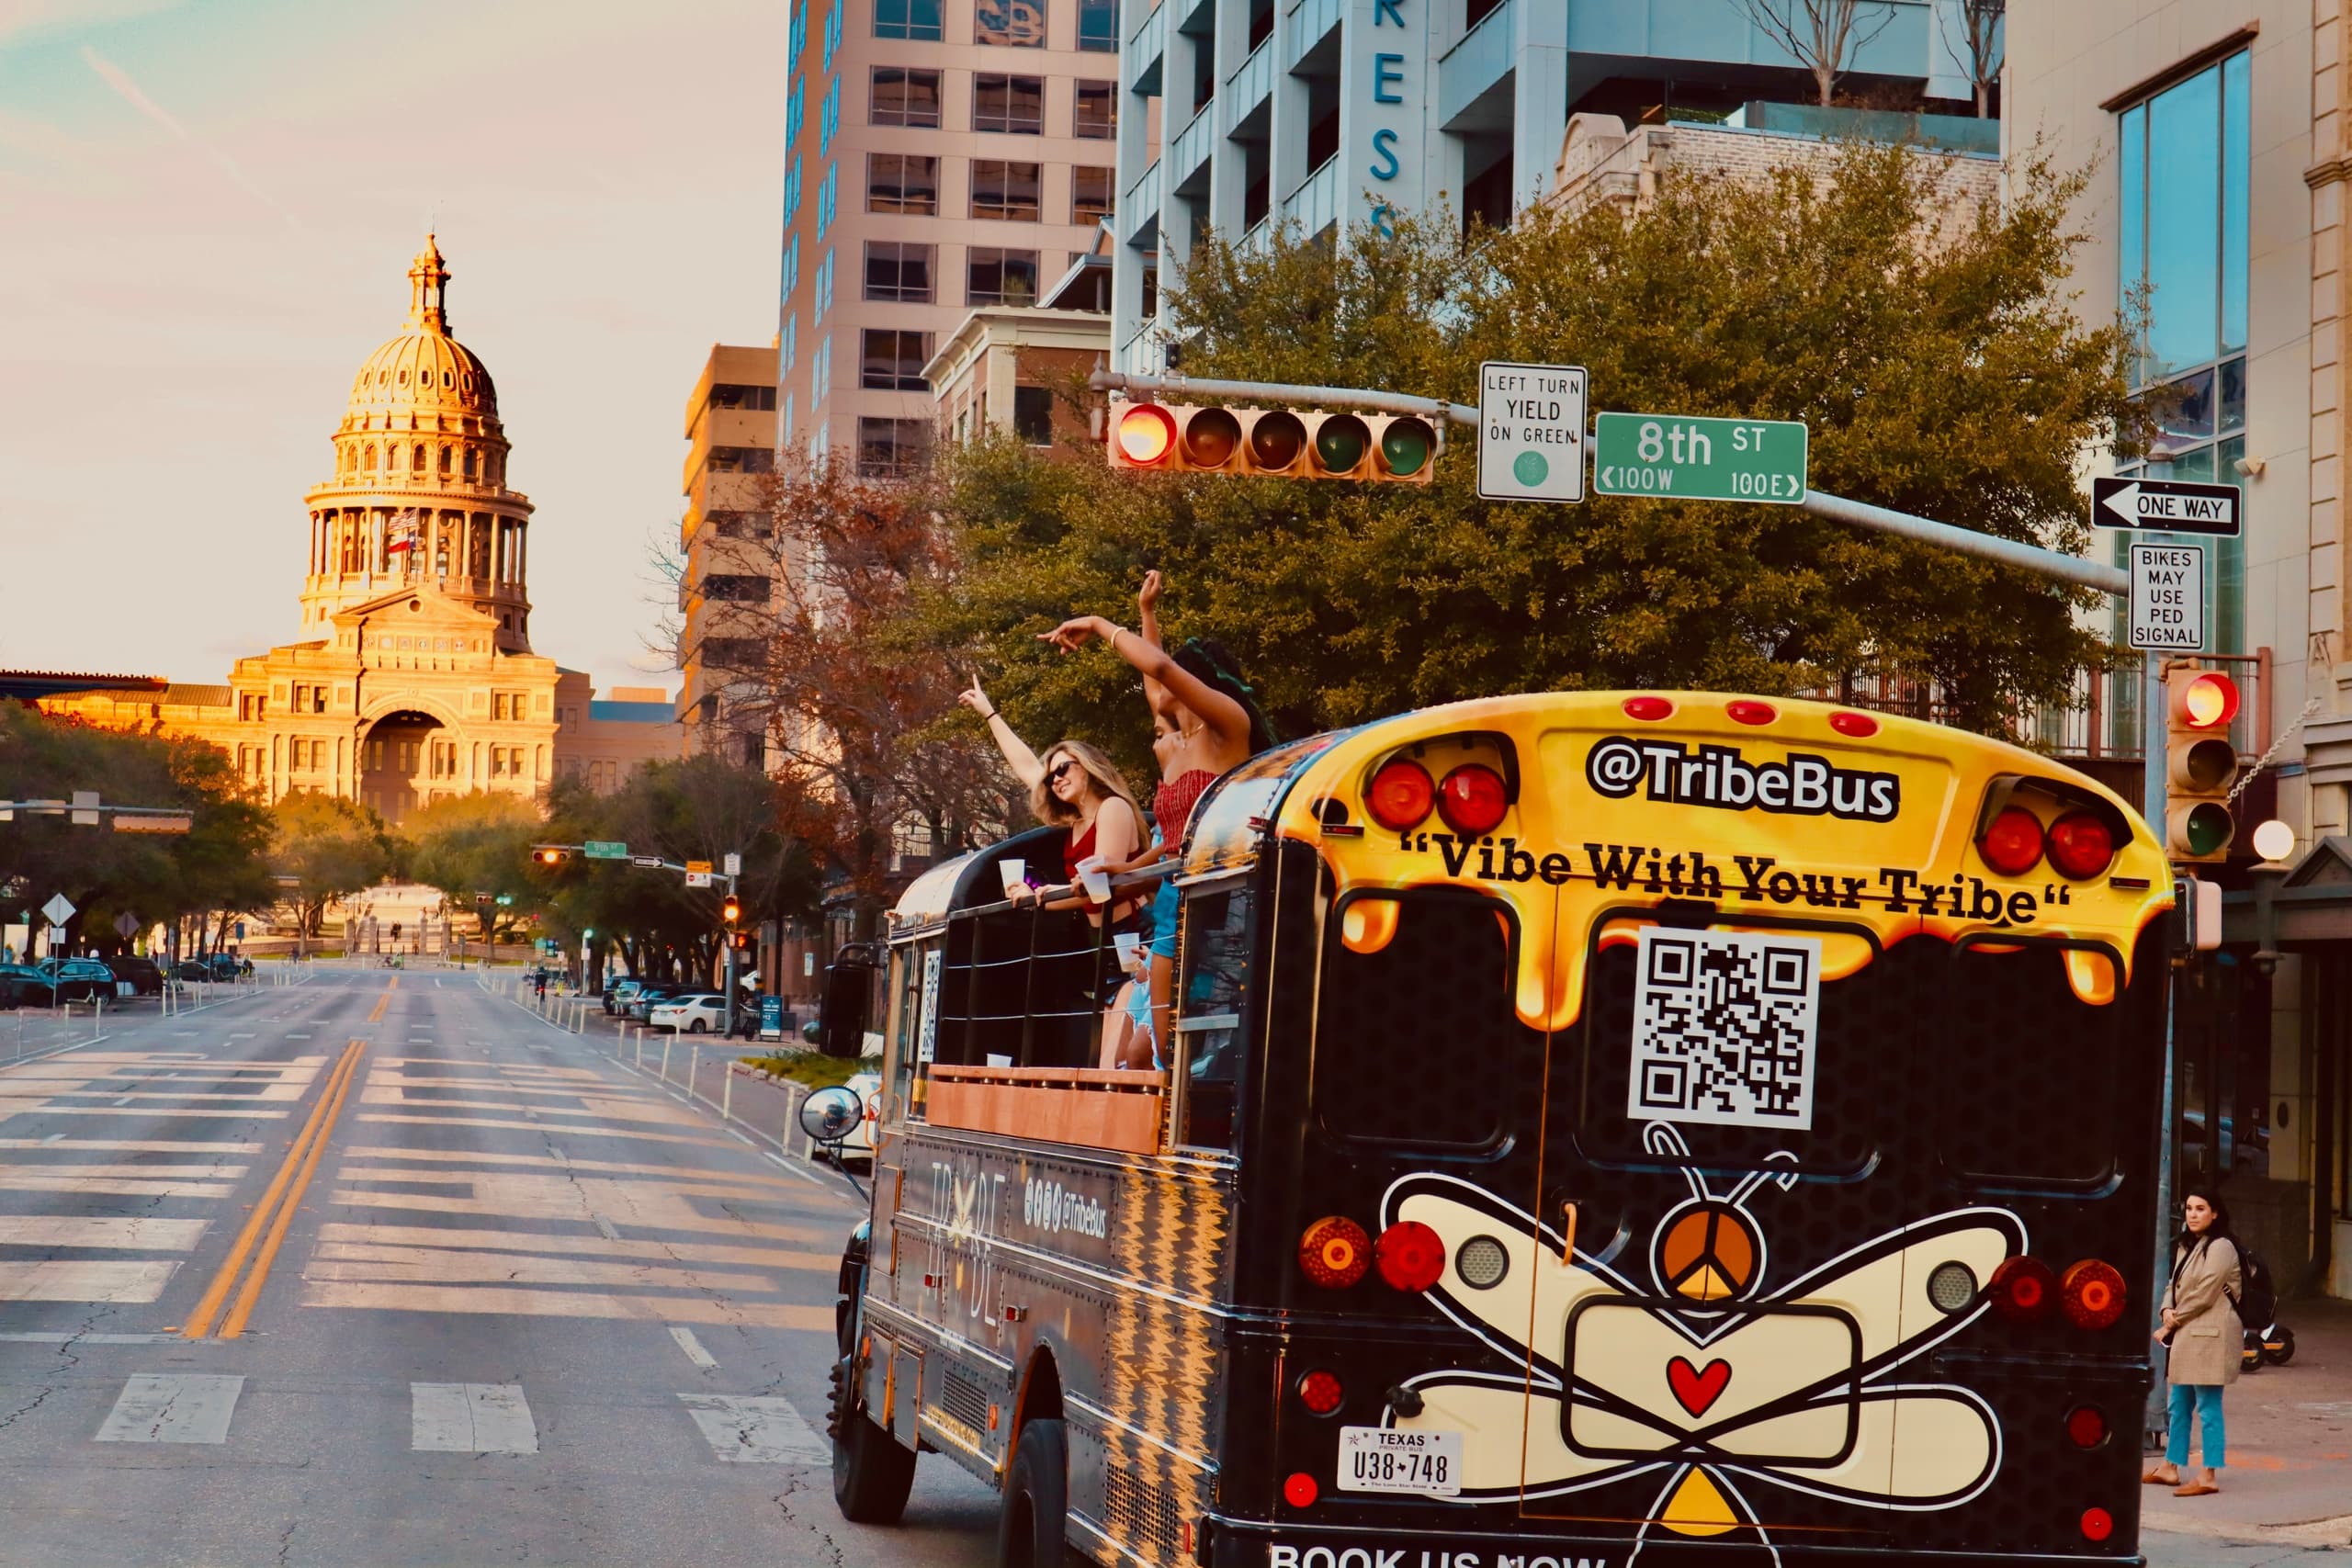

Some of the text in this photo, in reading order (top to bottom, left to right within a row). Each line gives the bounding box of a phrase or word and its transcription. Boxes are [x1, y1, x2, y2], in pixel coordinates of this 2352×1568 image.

[1487, 375, 1579, 394] LEFT TURN
[1507, 399, 1560, 421] YIELD
[1490, 425, 1575, 444] ON GREEN
[1637, 422, 1766, 465] 8th ST
[1618, 467, 1782, 496] 100W 100E
[2137, 496, 2223, 519] ONE WAY
[2143, 551, 2191, 566] BIKES
[2148, 570, 2185, 585] MAY
[2150, 590, 2183, 604] USE
[2150, 608, 2183, 624] PED
[2135, 627, 2198, 643] SIGNAL
[1592, 743, 1894, 817] @TribeBus
[1583, 842, 1723, 897] With
[1734, 855, 1867, 909] Your
[1063, 1191, 1106, 1239] @TribeBus
[1378, 1433, 1425, 1446] TEXAS
[1271, 1545, 1406, 1568] BOOK
